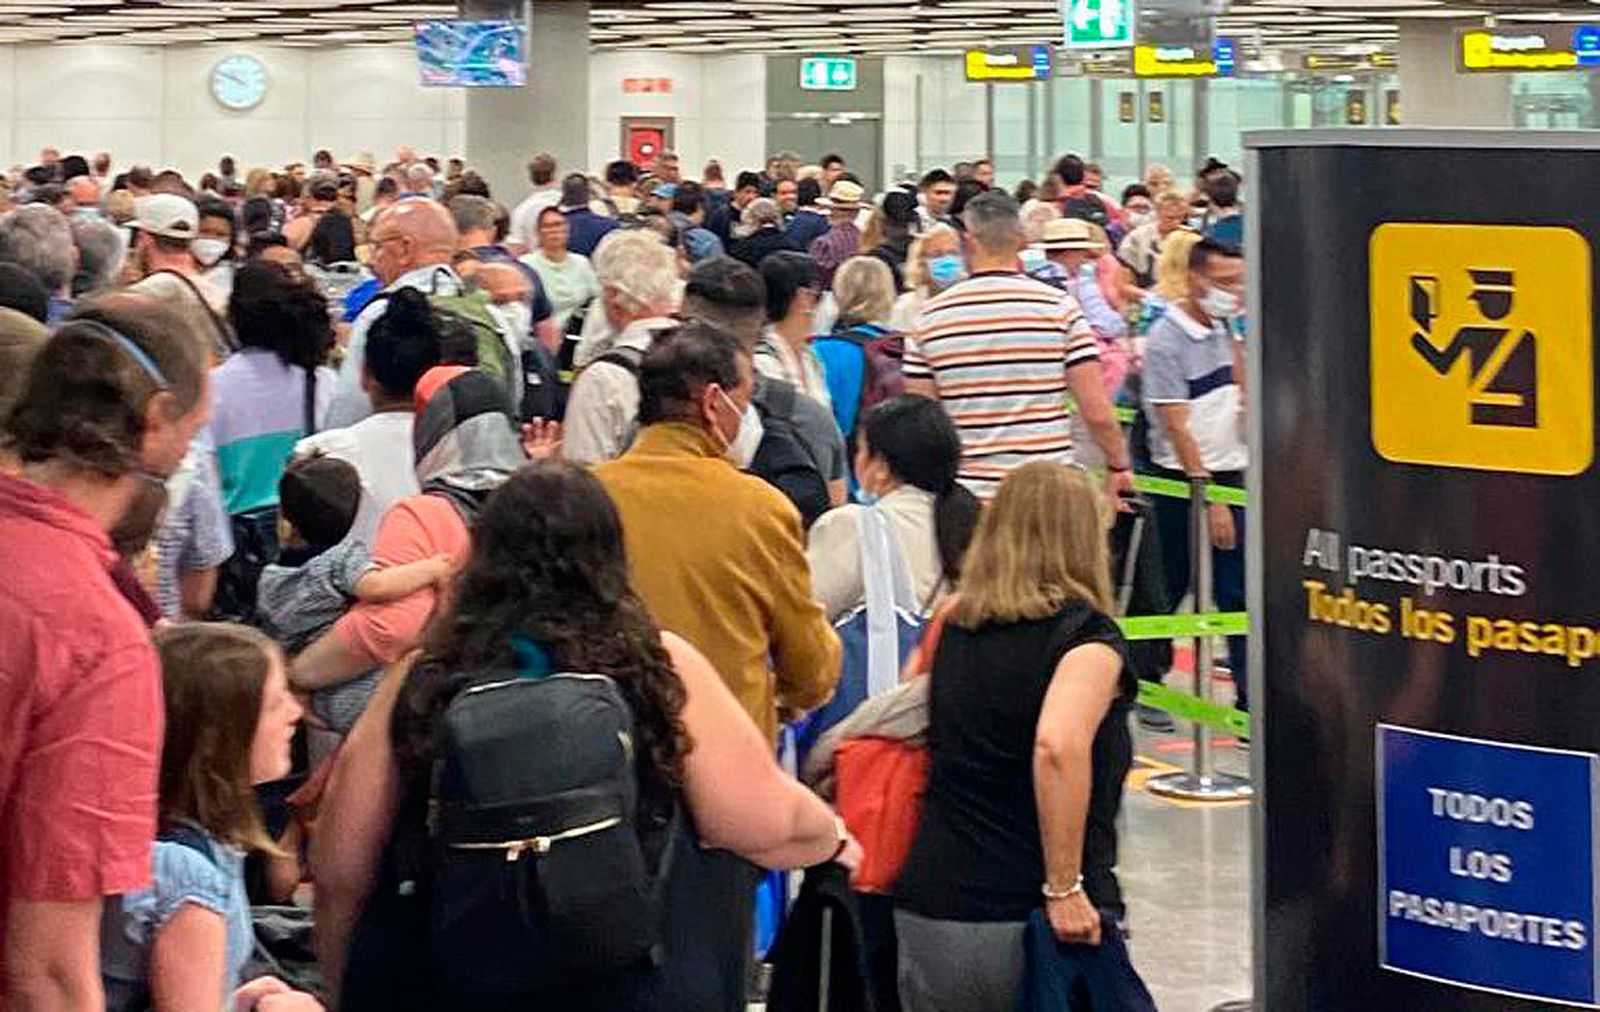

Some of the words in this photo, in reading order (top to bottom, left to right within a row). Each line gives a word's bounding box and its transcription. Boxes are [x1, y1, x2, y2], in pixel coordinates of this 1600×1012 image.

[1303, 528, 1340, 571] All
[1347, 545, 1527, 596] passports
[1302, 579, 1391, 633] Todos
[1400, 597, 1455, 643] los
[1467, 614, 1600, 667] pasap
[1427, 788, 1534, 829] TODOS
[1449, 847, 1513, 882] LOS
[1389, 890, 1587, 950] PASAPORTES
